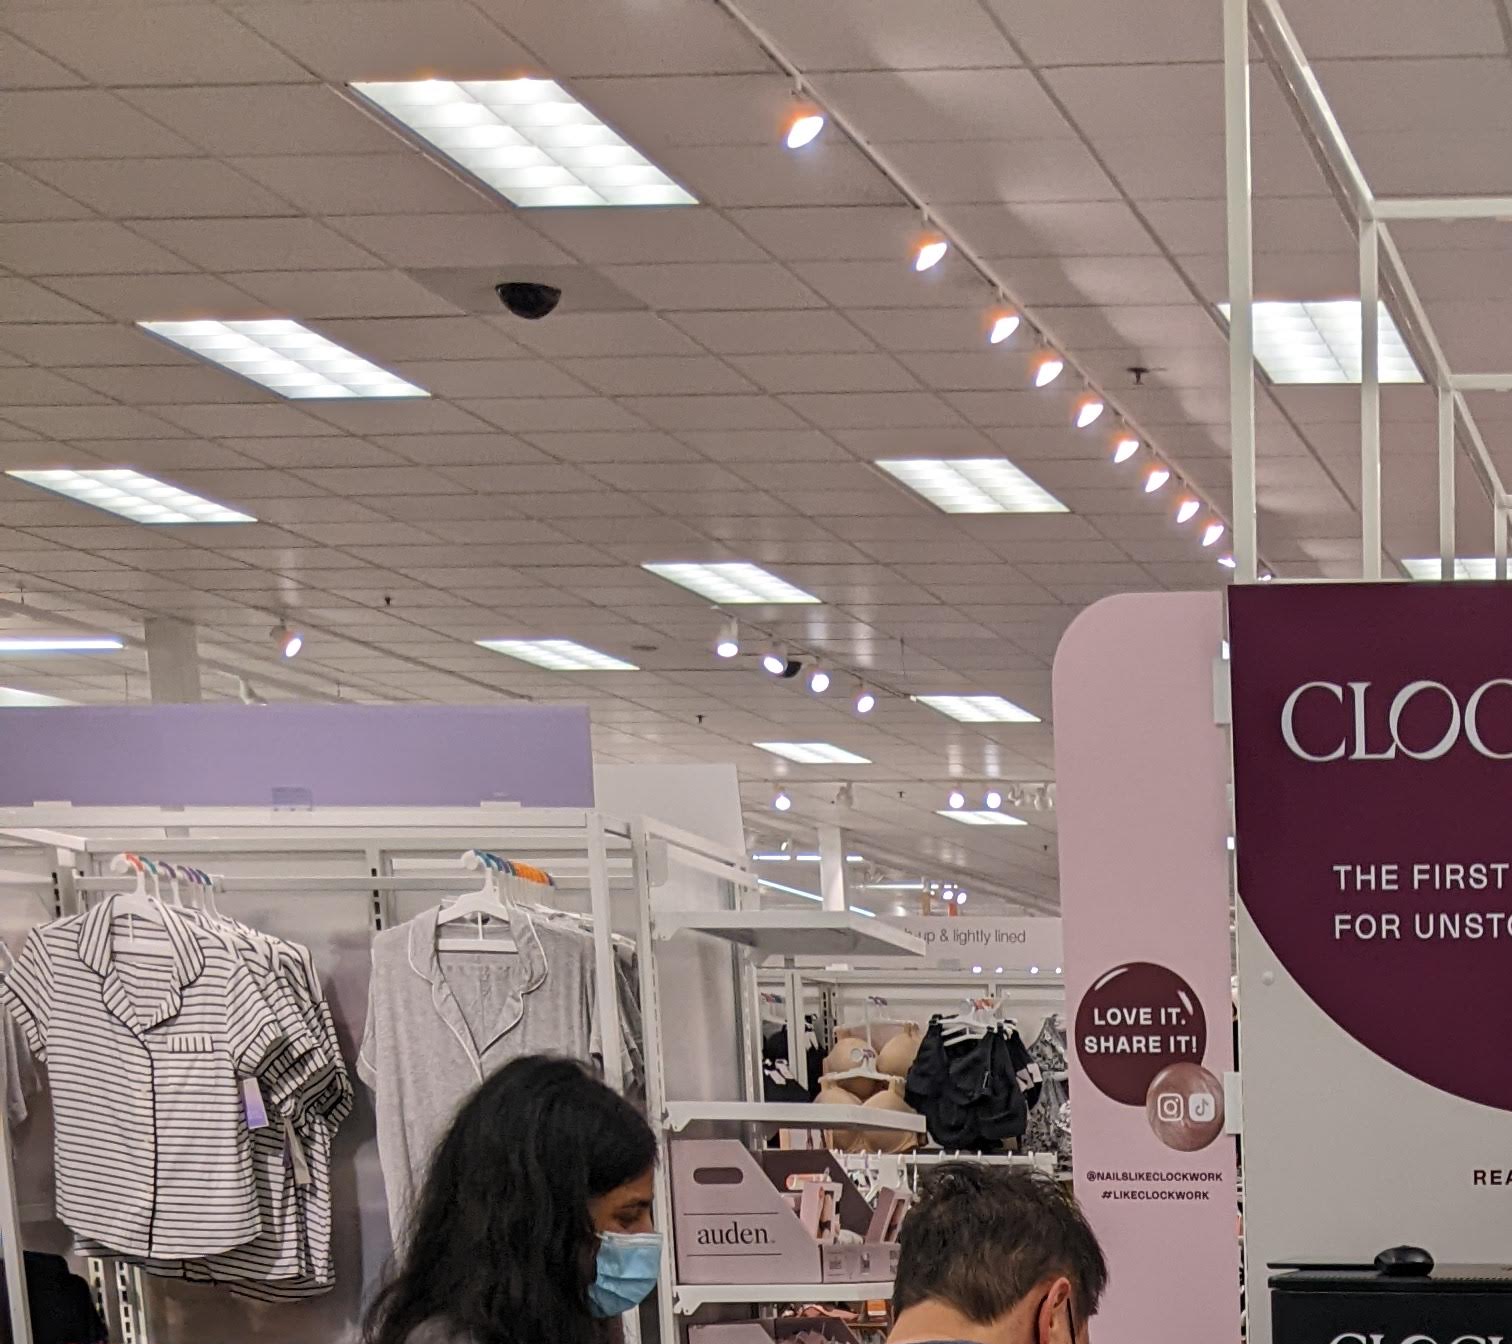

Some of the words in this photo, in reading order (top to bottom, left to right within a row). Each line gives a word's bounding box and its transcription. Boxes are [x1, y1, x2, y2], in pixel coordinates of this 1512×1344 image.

[1333, 864, 1400, 891] THE
[1413, 863, 1510, 890] FIRST
[1335, 913, 1401, 940] FOR
[940, 928, 949, 943] &
[954, 929, 991, 945] lightly
[995, 930, 1026, 943] lined
[1094, 1008, 1152, 1025] LOVE
[1160, 1008, 1186, 1025] IT.
[1084, 1036, 1161, 1053] SHARE
[1169, 1036, 1197, 1053] IT!
[1086, 1172, 1223, 1182] @NAILSLIKECLOCKWORK
[1101, 1190, 1209, 1200] #LIKECLOCKWORK
[697, 1221, 769, 1244] auden
